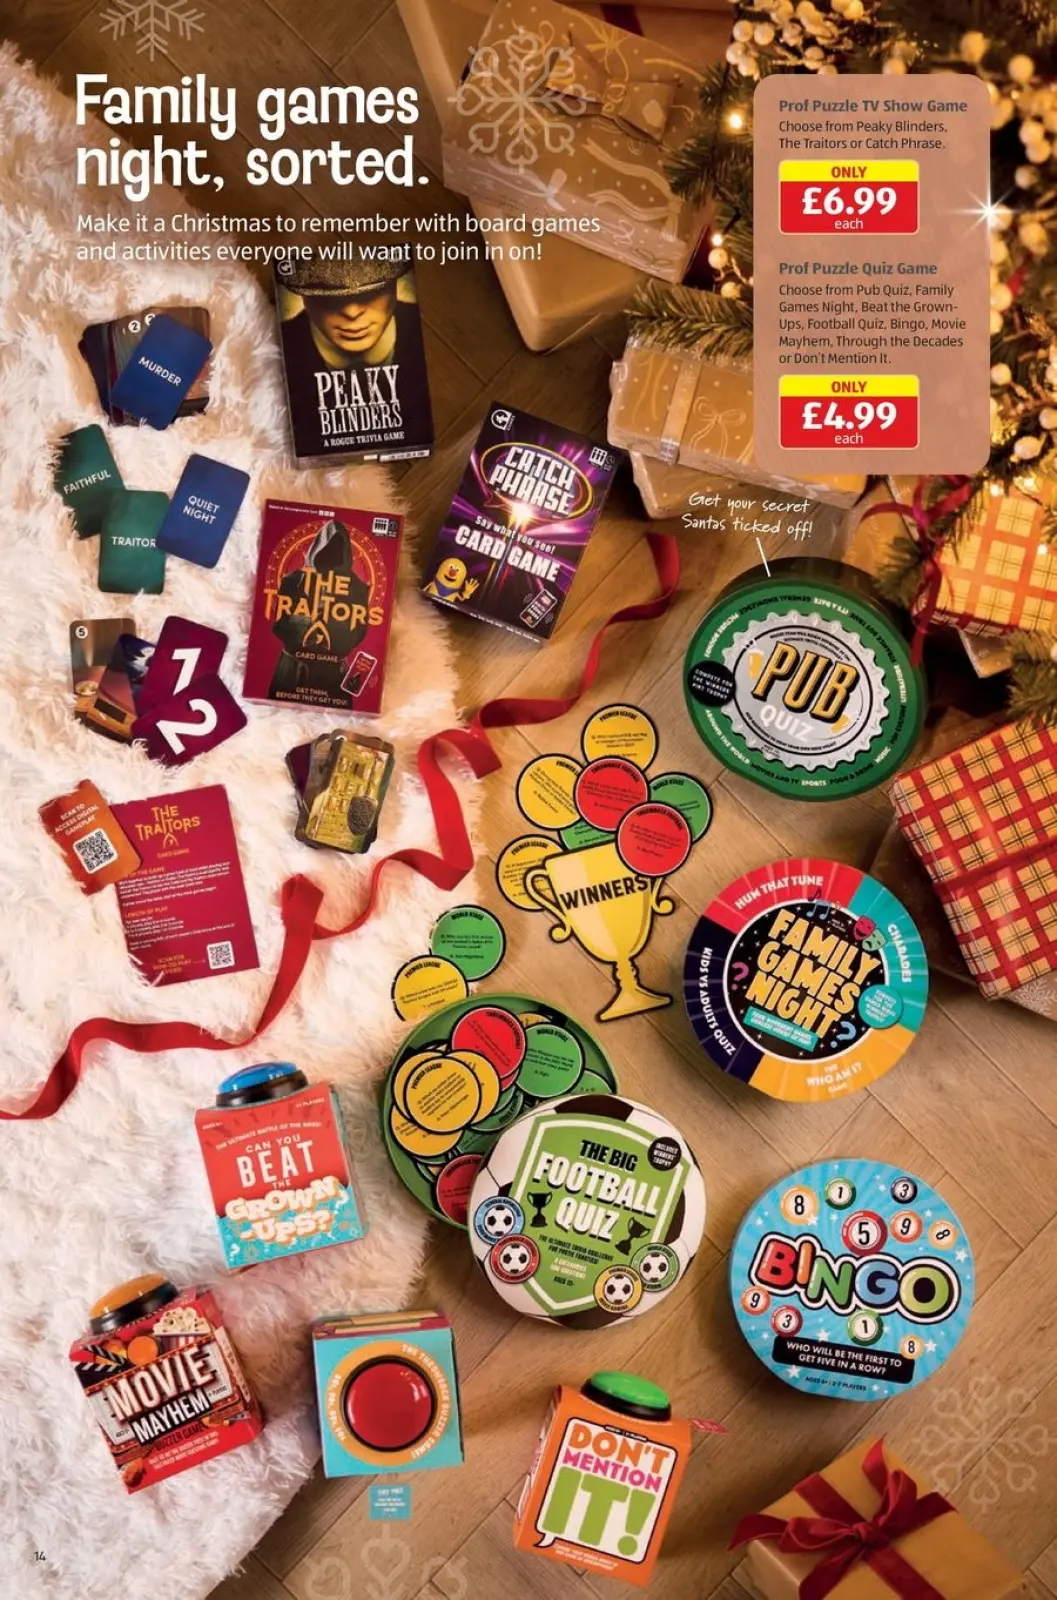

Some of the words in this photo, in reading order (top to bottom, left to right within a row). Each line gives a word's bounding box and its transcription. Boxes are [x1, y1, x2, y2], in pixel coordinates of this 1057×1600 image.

[779, 98, 810, 113] Prof
[812, 98, 859, 113] Puzzle
[861, 99, 880, 112] TV
[883, 99, 923, 113] Show
[927, 99, 968, 113] Game
[779, 120, 823, 133] Choose
[825, 120, 854, 132] from
[856, 120, 893, 135] Peaky
[779, 137, 801, 149] The
[803, 137, 848, 149] Traitors
[849, 140, 863, 149] or
[865, 137, 899, 149] Catch
[901, 137, 946, 149] Phrase.
[831, 166, 867, 178] ONLY
[802, 187, 897, 215] £6.99
[834, 219, 863, 229] each
[779, 261, 810, 275] Prof
[812, 261, 859, 275] Puzzle
[861, 261, 894, 277] Quiz
[896, 262, 938, 275] Game
[779, 284, 823, 296] Choose
[825, 283, 854, 296] from
[856, 284, 881, 296] Pub
[882, 283, 912, 298] Quiz,
[915, 284, 955, 299] Family
[779, 301, 820, 313] Games
[822, 300, 858, 316] Night,
[861, 301, 889, 313] Beat
[890, 301, 911, 313] the
[913, 301, 958, 313] Grown-
[779, 318, 805, 332] Ups,
[807, 317, 855, 330] Football
[857, 317, 887, 332] Quiz,
[890, 317, 929, 333] Bingo,
[931, 317, 966, 330] Movie
[779, 335, 834, 350] Mayhem,
[836, 335, 888, 350] Through
[890, 335, 910, 347] the
[913, 335, 964, 347] Decades
[138, 356, 182, 386] MURDER
[779, 355, 792, 364] or
[794, 352, 826, 364] Don't
[827, 352, 877, 364] Mention
[879, 352, 892, 364] It.
[314, 365, 399, 411] PEAKY
[831, 381, 867, 393] ONLY
[319, 402, 403, 436] BLINDERS
[802, 401, 897, 430] £4.99
[324, 439, 330, 447] A
[330, 436, 354, 446] ROGUE
[356, 434, 382, 444] TRIVIA
[384, 431, 404, 441] GAME
[834, 433, 863, 444] each
[63, 470, 112, 494] FAITHFUL
[504, 446, 577, 491] CATCH
[488, 465, 575, 515] PHRASE
[182, 505, 216, 525] NIGHT
[188, 495, 220, 513] QUIET
[493, 524, 515, 538] what
[517, 534, 534, 547] you
[535, 542, 556, 554] see!
[455, 524, 506, 560] CARD
[507, 546, 561, 582] GAME
[302, 566, 351, 595] THE
[264, 588, 384, 632] TRAITORS
[78, 627, 86, 637] 5
[750, 640, 861, 724] PUB
[156, 698, 218, 756] 2
[759, 705, 816, 742] QUIZ
[559, 876, 650, 911] WINNERS
[735, 888, 761, 910] HUM
[763, 878, 790, 896] THAT
[792, 875, 824, 887] TUNE
[699, 947, 713, 973] KIDS
[768, 908, 881, 985] FAMILY
[887, 924, 912, 983] CHARADES
[699, 974, 709, 988] VS
[757, 941, 861, 1015] GAMES
[699, 990, 718, 1029] ADULTS
[745, 970, 842, 1039] NIGHT
[713, 1027, 737, 1057] QUIZ
[245, 1140, 271, 1153] CAN
[276, 1134, 301, 1146] YOU
[580, 1139, 608, 1164] THE
[609, 1149, 638, 1173] BIG
[236, 1140, 314, 1188] BEAT
[272, 1178, 291, 1189] THE
[532, 1152, 662, 1218] FOOTBALL
[838, 1186, 844, 1199] 1
[899, 1183, 909, 1198] 3
[225, 1176, 341, 1222] GROWN
[794, 1195, 804, 1215] 8
[555, 1196, 621, 1243] QUIZ
[858, 1221, 870, 1245] 5
[900, 1217, 911, 1236] 9
[754, 1236, 955, 1318] BINGO
[750, 1291, 760, 1308] 9
[783, 1313, 793, 1328] 3
[862, 1319, 868, 1334] 1
[786, 1341, 811, 1352] WHO
[812, 1345, 833, 1356] WILL
[834, 1349, 845, 1358] BE
[847, 1351, 863, 1361] THE
[865, 1354, 888, 1365] FIRST
[890, 1358, 902, 1367] TO
[907, 1340, 916, 1353] 8
[799, 1353, 815, 1363] GET
[817, 1356, 835, 1366] FIVE
[837, 1360, 848, 1368] IN
[849, 1362, 856, 1370] A
[858, 1364, 886, 1375] ROW?
[103, 1345, 216, 1421] MOVIE
[131, 1390, 211, 1443] MAYHEM
[568, 1423, 670, 1475] DON'T
[562, 1450, 662, 1492] MENTION
[541, 1466, 656, 1557] IT!
